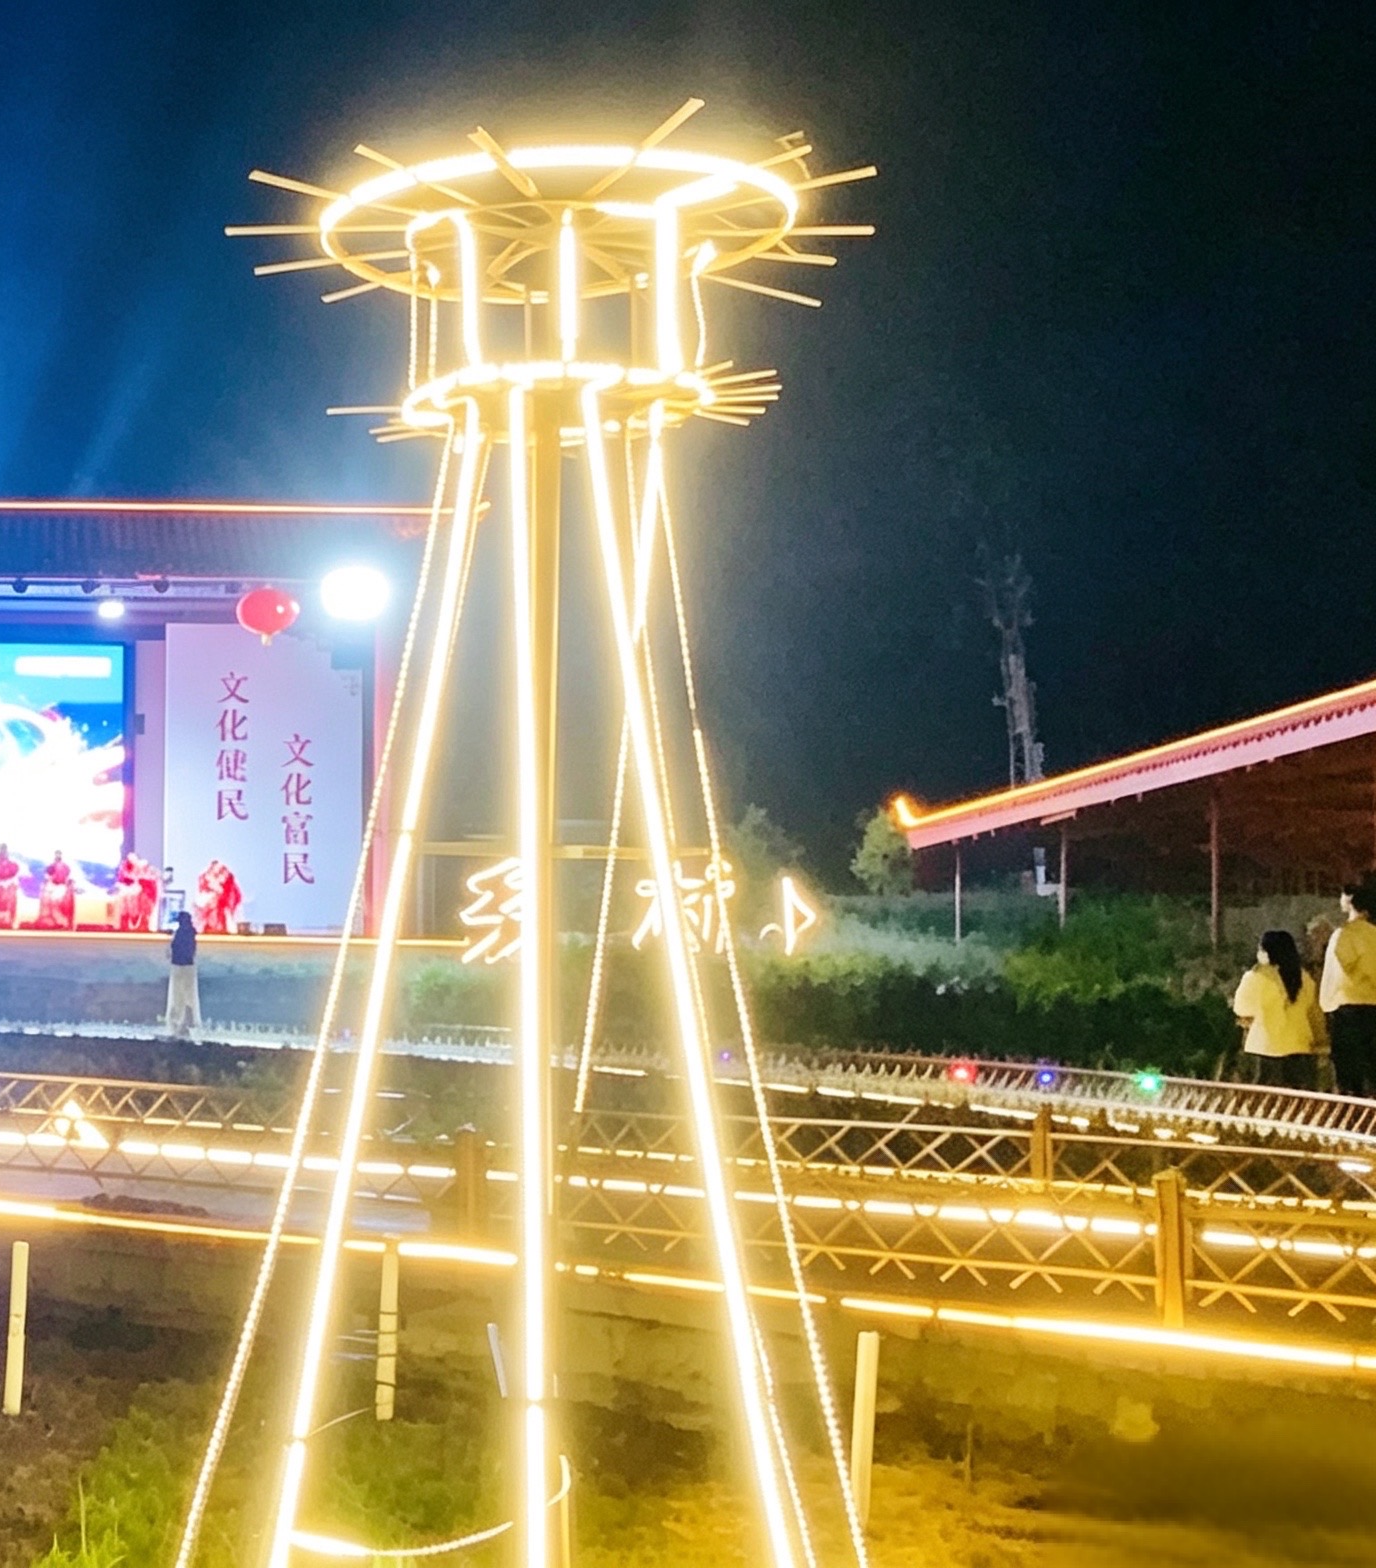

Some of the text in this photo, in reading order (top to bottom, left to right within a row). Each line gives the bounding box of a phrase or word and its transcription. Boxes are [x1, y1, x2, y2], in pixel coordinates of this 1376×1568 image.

[215, 671, 250, 821] 文化健民
[280, 733, 315, 885] 文化富民
